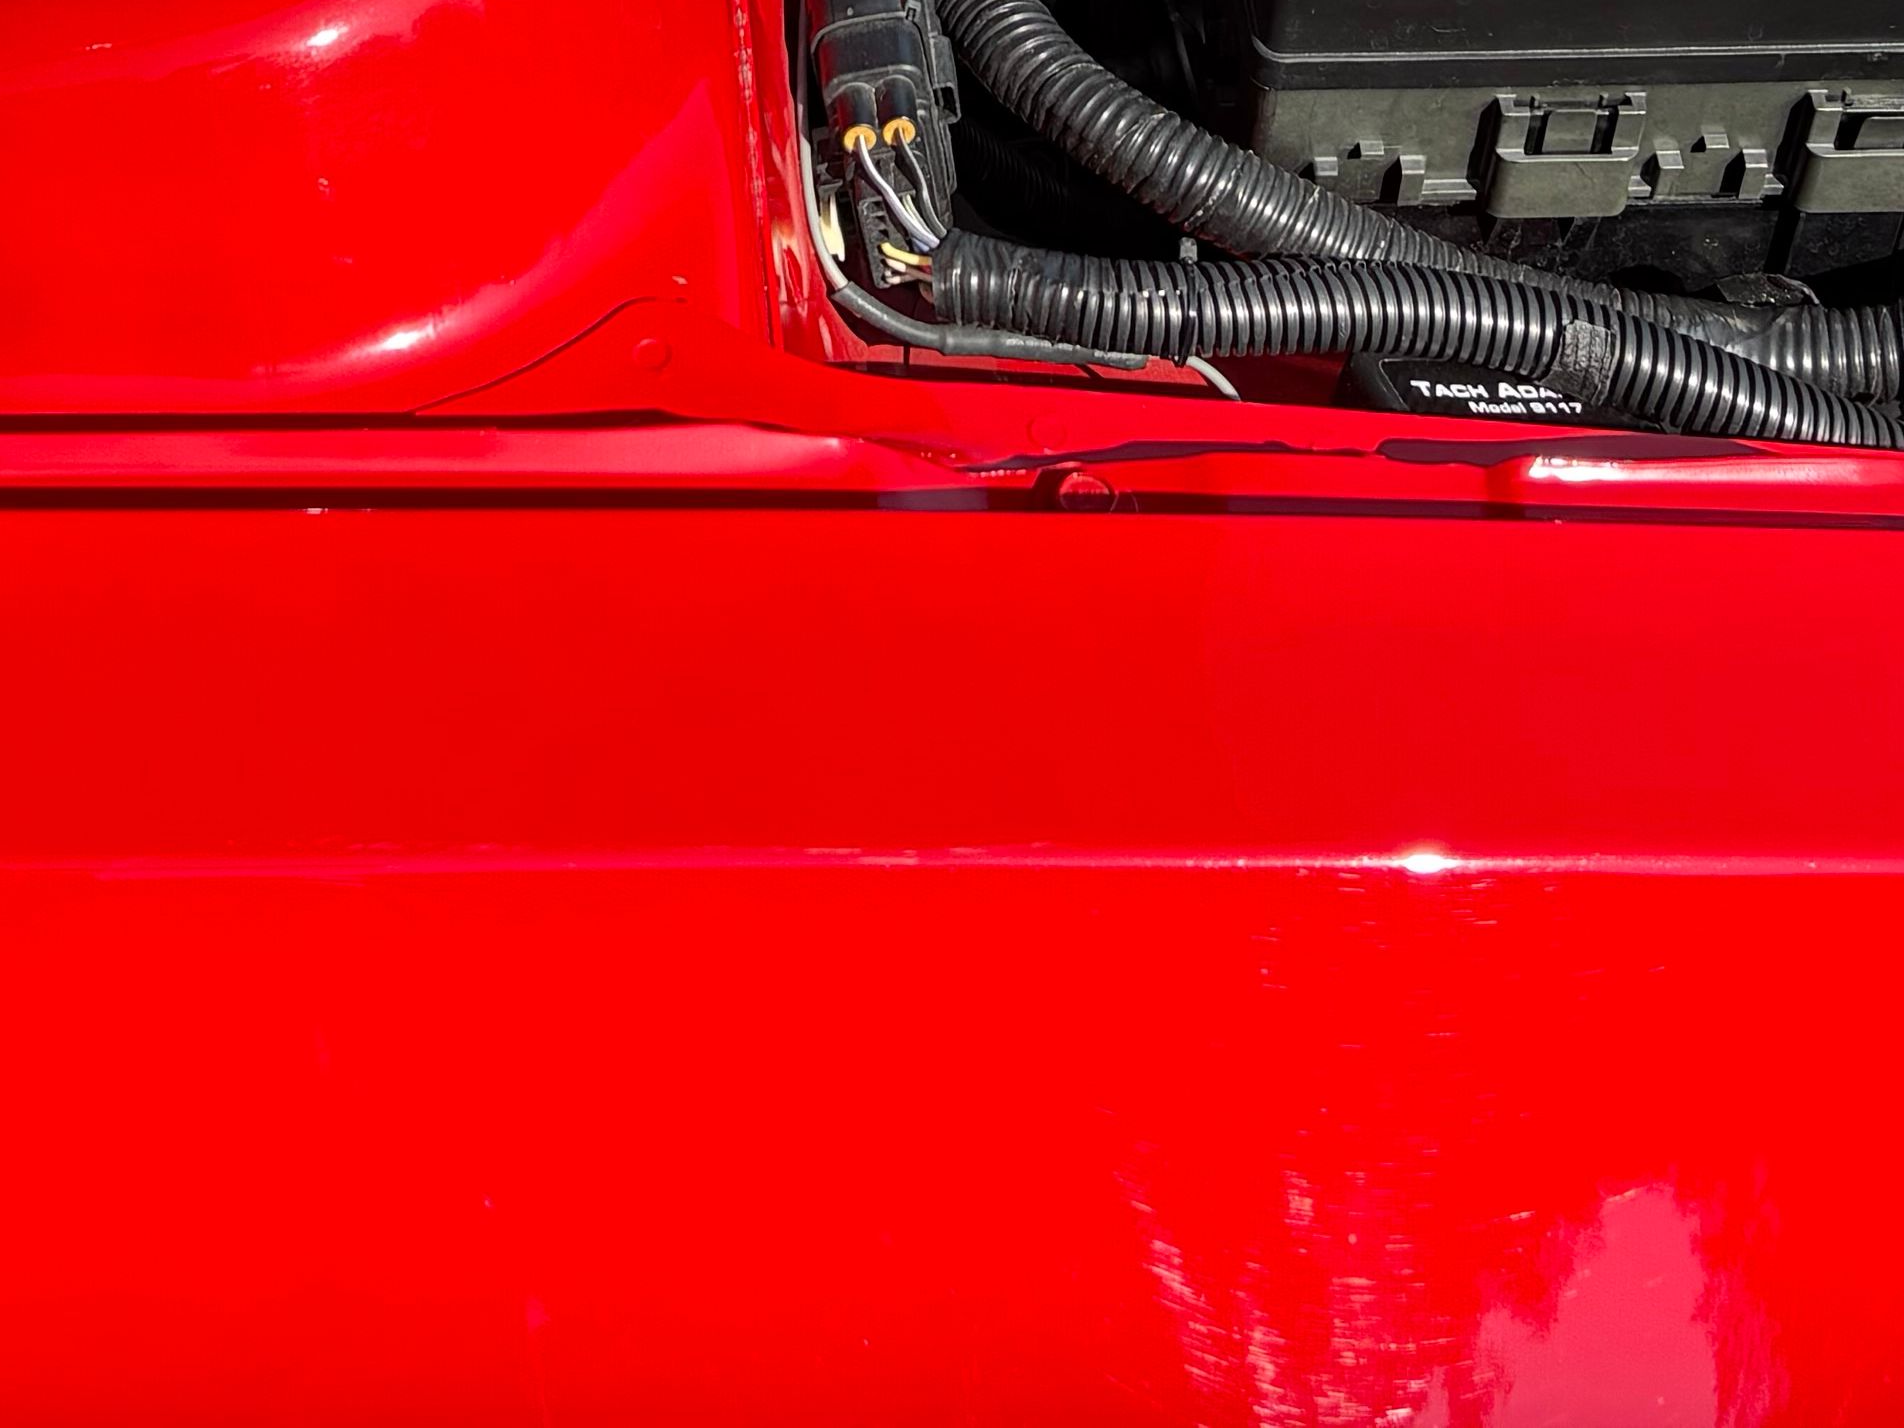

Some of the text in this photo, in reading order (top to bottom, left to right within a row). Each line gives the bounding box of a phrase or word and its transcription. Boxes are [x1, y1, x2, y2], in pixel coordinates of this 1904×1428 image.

[1498, 382, 1563, 399] ADA
[1468, 401, 1583, 415] Model 9117
